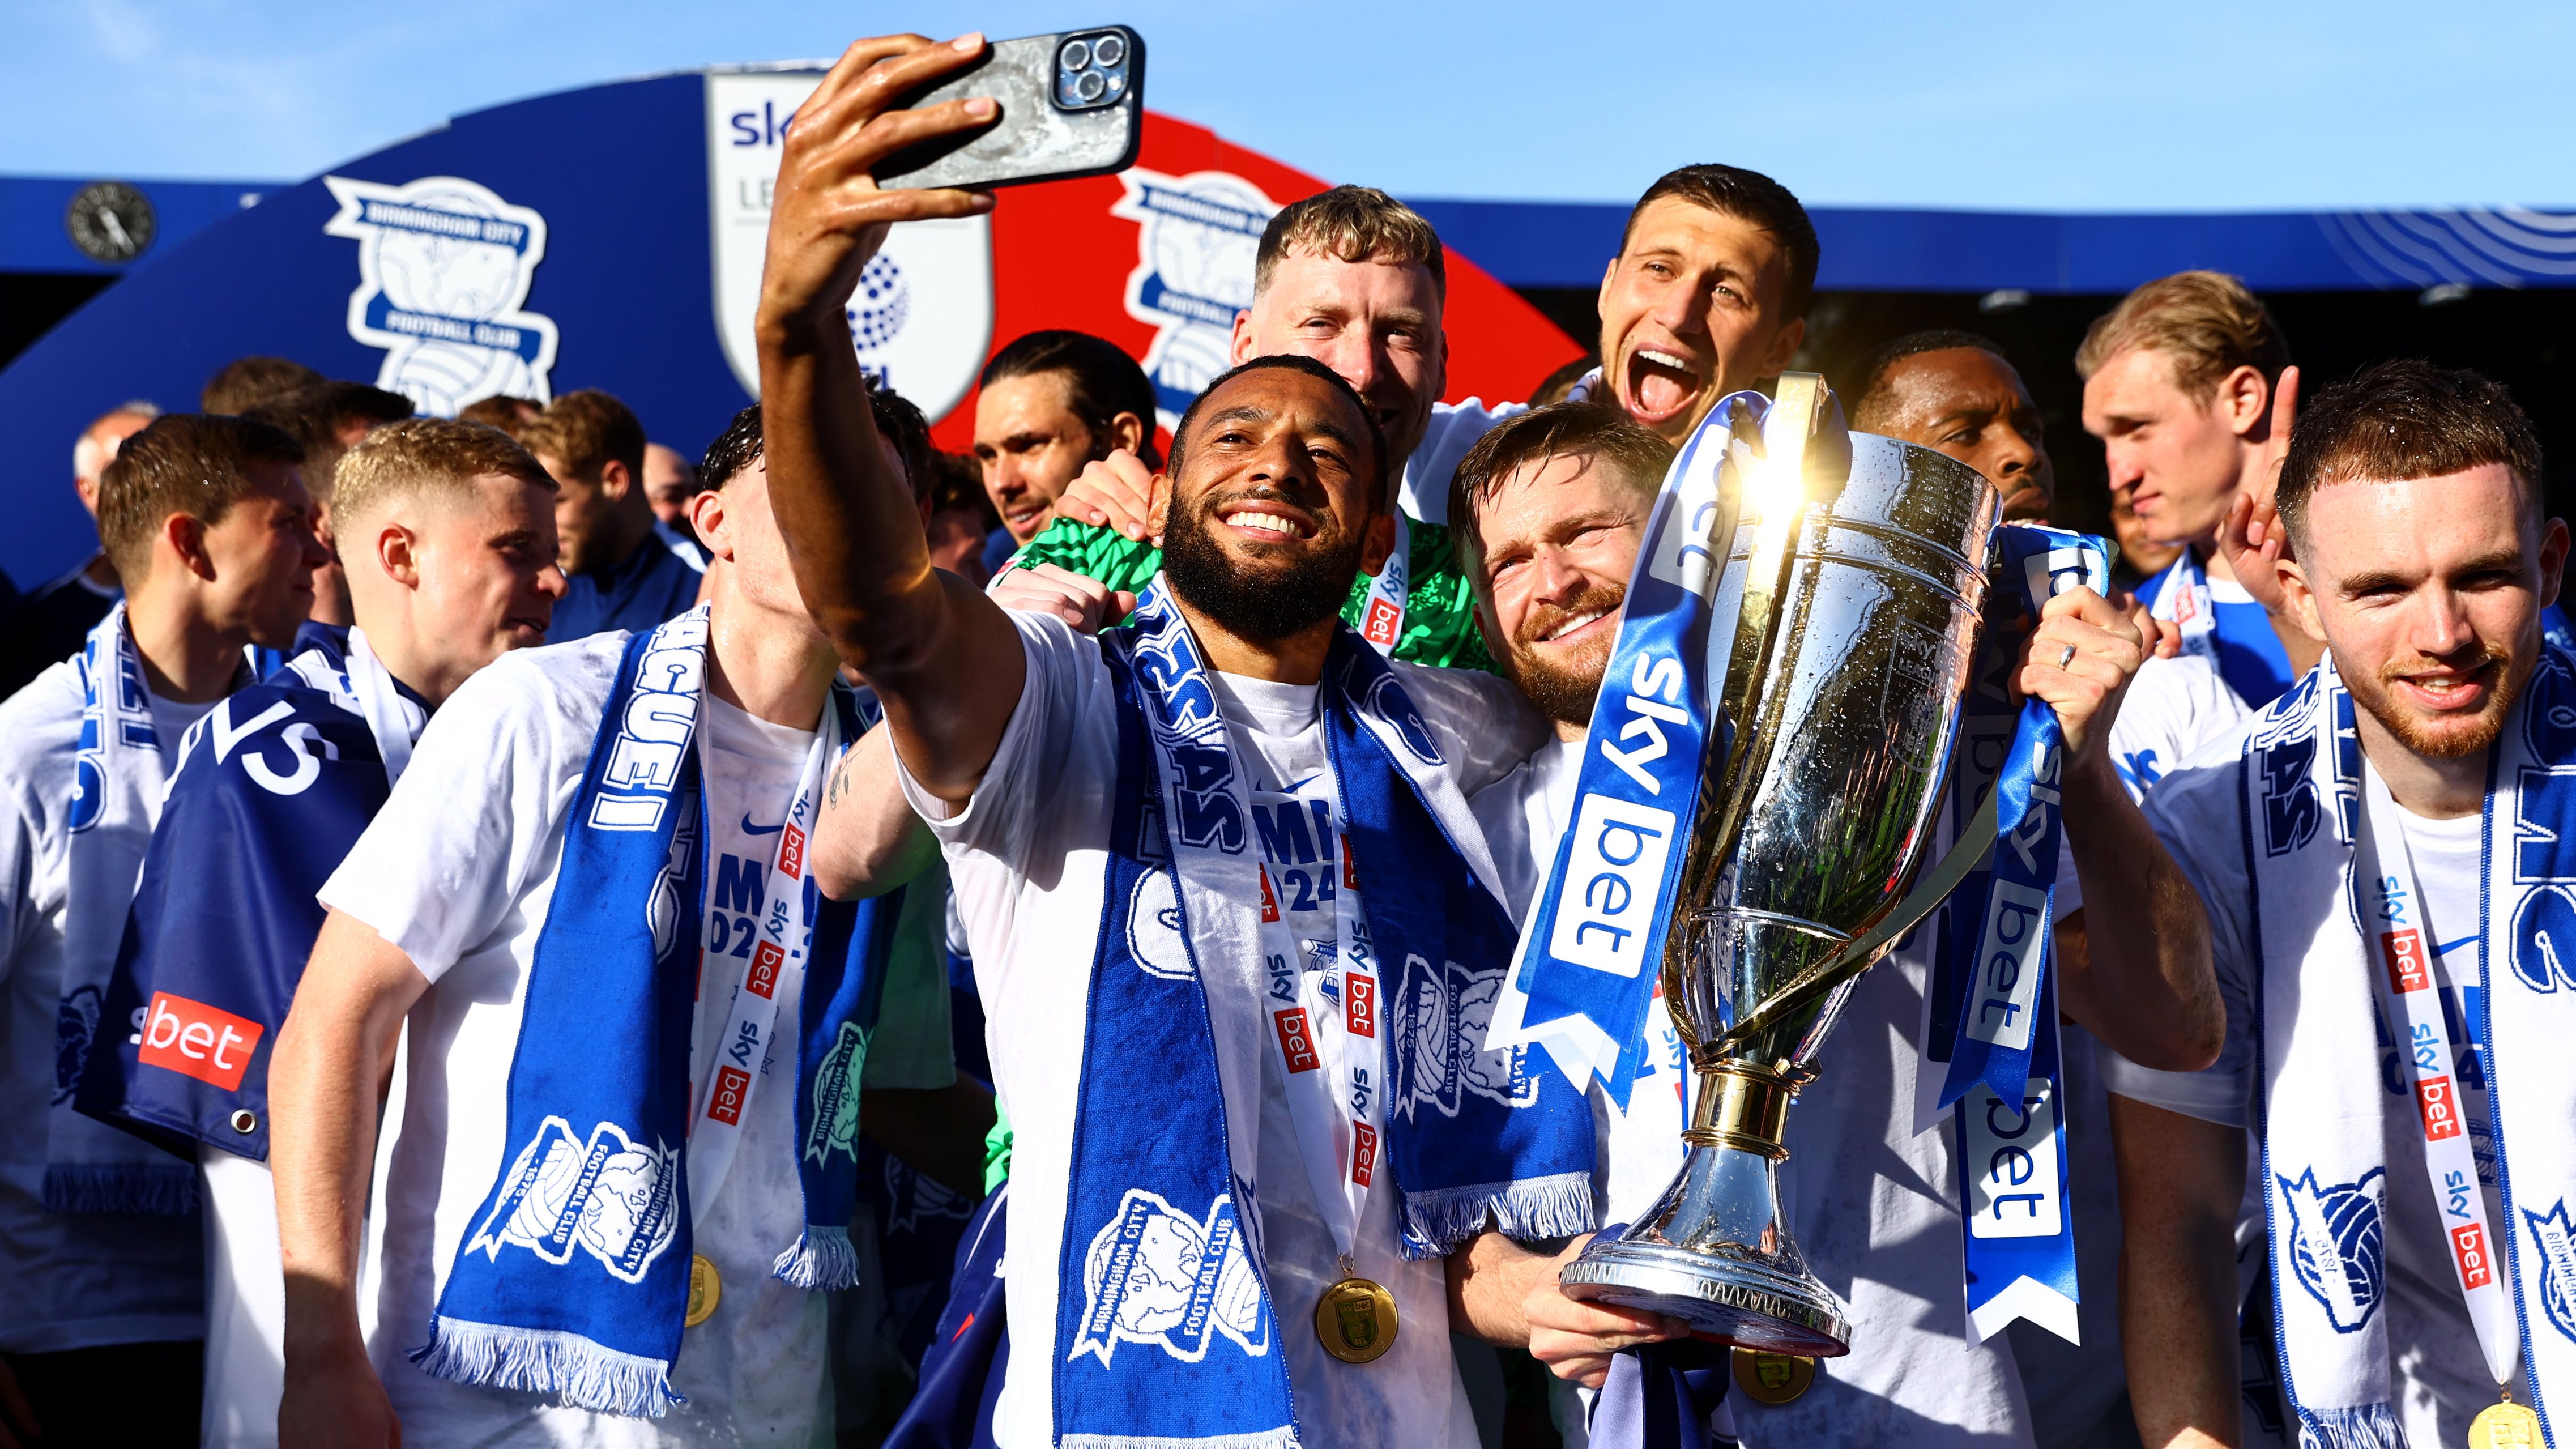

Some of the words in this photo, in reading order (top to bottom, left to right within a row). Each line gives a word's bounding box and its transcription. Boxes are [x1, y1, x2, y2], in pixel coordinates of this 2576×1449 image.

[731, 102, 794, 146] sk
[365, 201, 481, 240] BIRMINGHAM
[483, 220, 524, 246] CITY
[386, 311, 471, 340] FOOTBALL
[474, 324, 522, 351] CLUB
[1380, 562, 1404, 602] sky
[1371, 604, 1397, 641] bet
[1601, 651, 1688, 796] sky
[2011, 741, 2062, 876] sky
[784, 830, 803, 872] bet
[1576, 818, 1662, 953] bet
[2377, 876, 2407, 924] sky
[765, 898, 789, 943] sky
[1347, 920, 1373, 971] sky
[753, 947, 782, 995] bet
[1980, 899, 2039, 1029] bet
[2391, 935, 2422, 987] bet
[1266, 954, 1296, 1003] sky
[1283, 1015, 1313, 1066] bet
[1352, 980, 1372, 1032] bet
[1448, 984, 1460, 1052] FOOTBALL
[146, 1000, 242, 1069] bet
[729, 1020, 760, 1067] sky
[2411, 1022, 2440, 1072] sky
[716, 1072, 747, 1119] bet
[816, 1067, 845, 1140] BIRMINGHAM
[840, 1034, 854, 1063] CITY
[1351, 1067, 1371, 1120] sky
[1445, 1058, 1457, 1094] CLUB
[2423, 1082, 2454, 1135] bet
[569, 1144, 609, 1208] FOOTBALL
[1357, 1127, 1374, 1183] bet
[1986, 1096, 2045, 1221] bet
[639, 1163, 672, 1237] BIRMINGHAM
[552, 1211, 577, 1245] CLUB
[2445, 1170, 2471, 1218] sky
[2458, 1229, 2486, 1283] bet
[624, 1238, 647, 1271] CITY
[1091, 1243, 1133, 1332] BIRMINGHAM
[1124, 1203, 1146, 1239] CITY
[1184, 1259, 1219, 1336] FOOTBALL
[1208, 1218, 1233, 1256] CLUB
